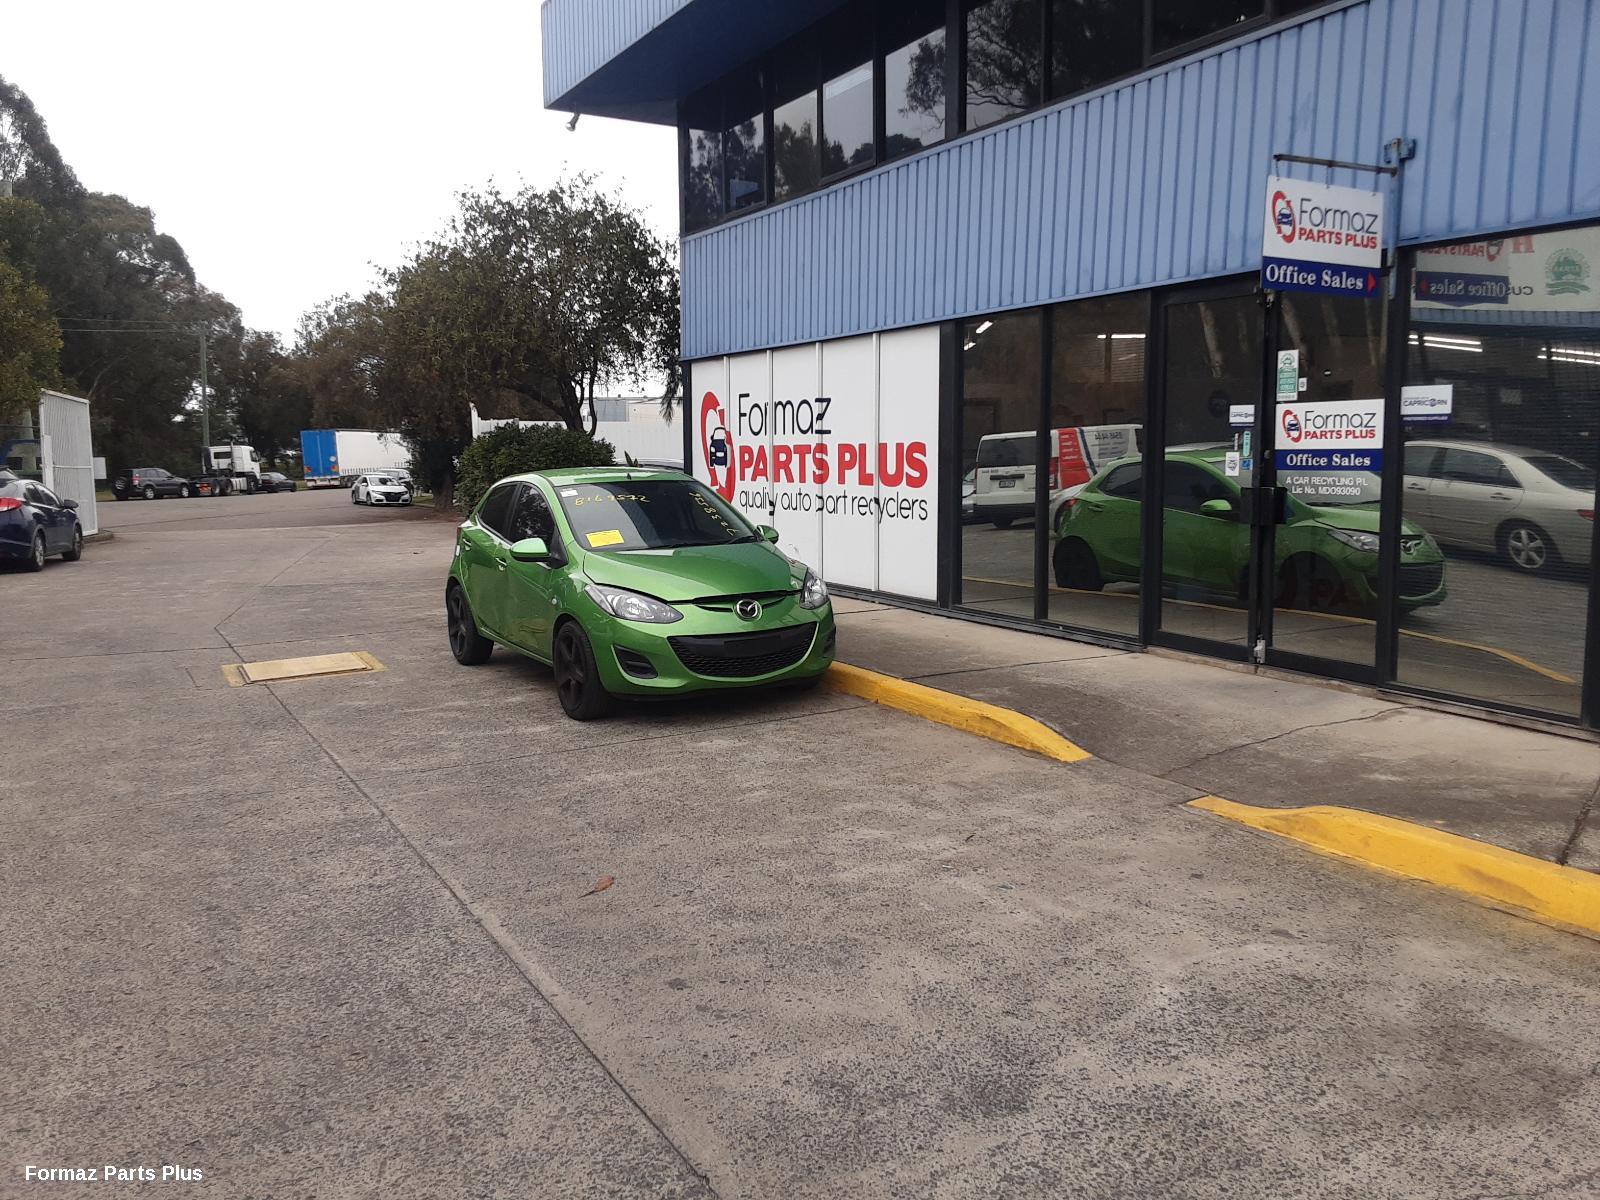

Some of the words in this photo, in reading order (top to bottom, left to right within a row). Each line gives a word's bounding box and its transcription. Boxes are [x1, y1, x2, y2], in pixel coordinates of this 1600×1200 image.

[1299, 197, 1379, 235] Formaz
[1298, 227, 1342, 245] PARTS
[1344, 233, 1377, 249] PLUS
[1266, 263, 1317, 286] Office
[1321, 269, 1364, 290] Sales
[739, 393, 831, 436] Formaz
[1304, 410, 1376, 429] Formaz
[1304, 430, 1342, 439] PARTS
[1345, 429, 1376, 438] PLUS
[739, 443, 830, 485] PARTS
[837, 441, 928, 488] PLUS
[1286, 454, 1328, 466] Office
[1332, 453, 1371, 466] Sales
[1293, 477, 1309, 485] CAR
[1311, 476, 1354, 486] RECYCLING
[739, 487, 778, 516] qualiy
[781, 488, 812, 512] auto
[851, 491, 928, 525] recyclers
